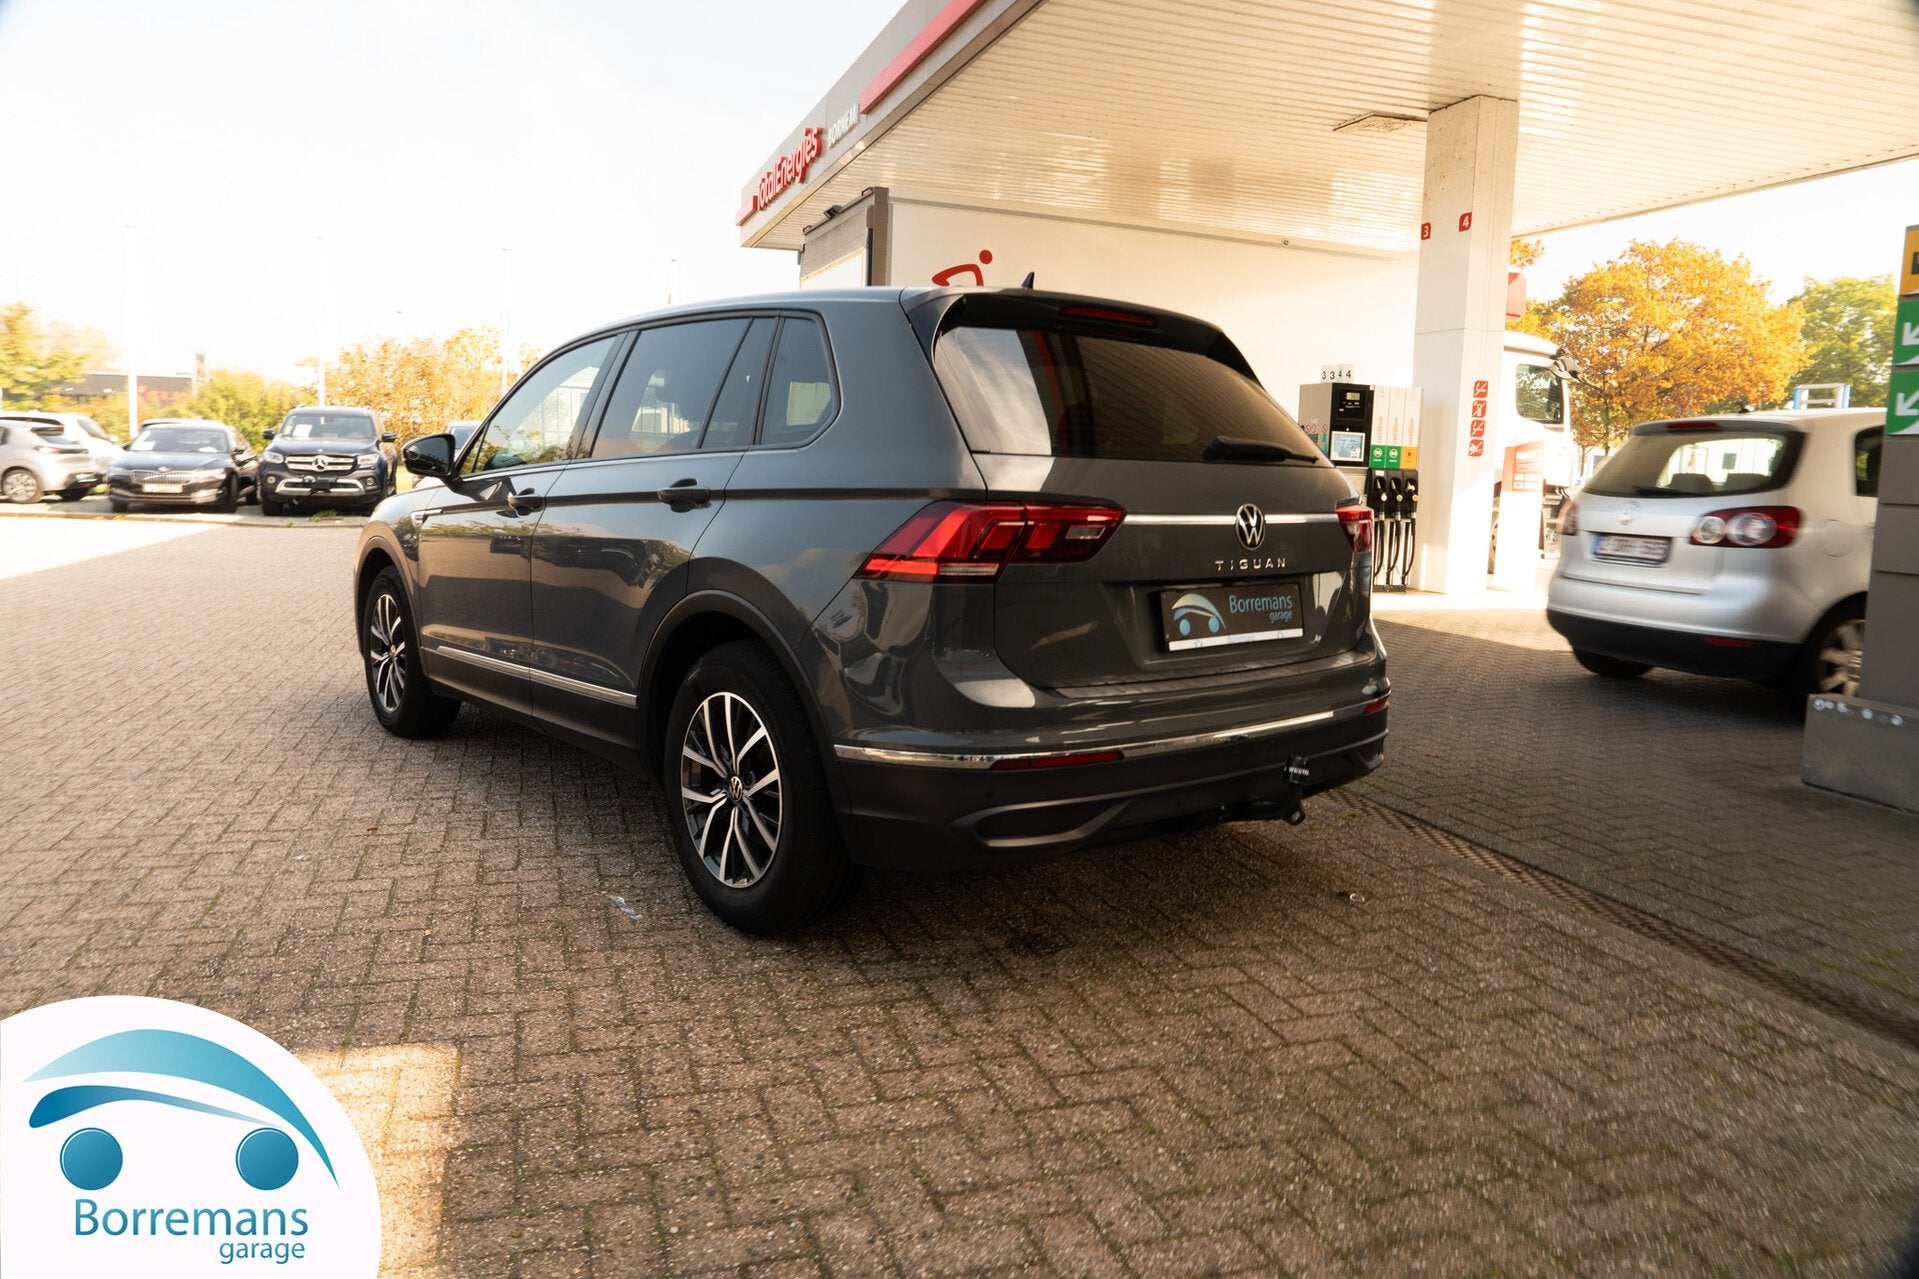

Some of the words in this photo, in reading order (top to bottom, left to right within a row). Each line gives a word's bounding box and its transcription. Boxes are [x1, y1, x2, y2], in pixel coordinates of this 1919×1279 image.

[828, 103, 859, 148] BORNEM
[1215, 557, 1286, 571] TIGUAN
[1229, 595, 1292, 613] Borremans
[1270, 610, 1292, 623] garage
